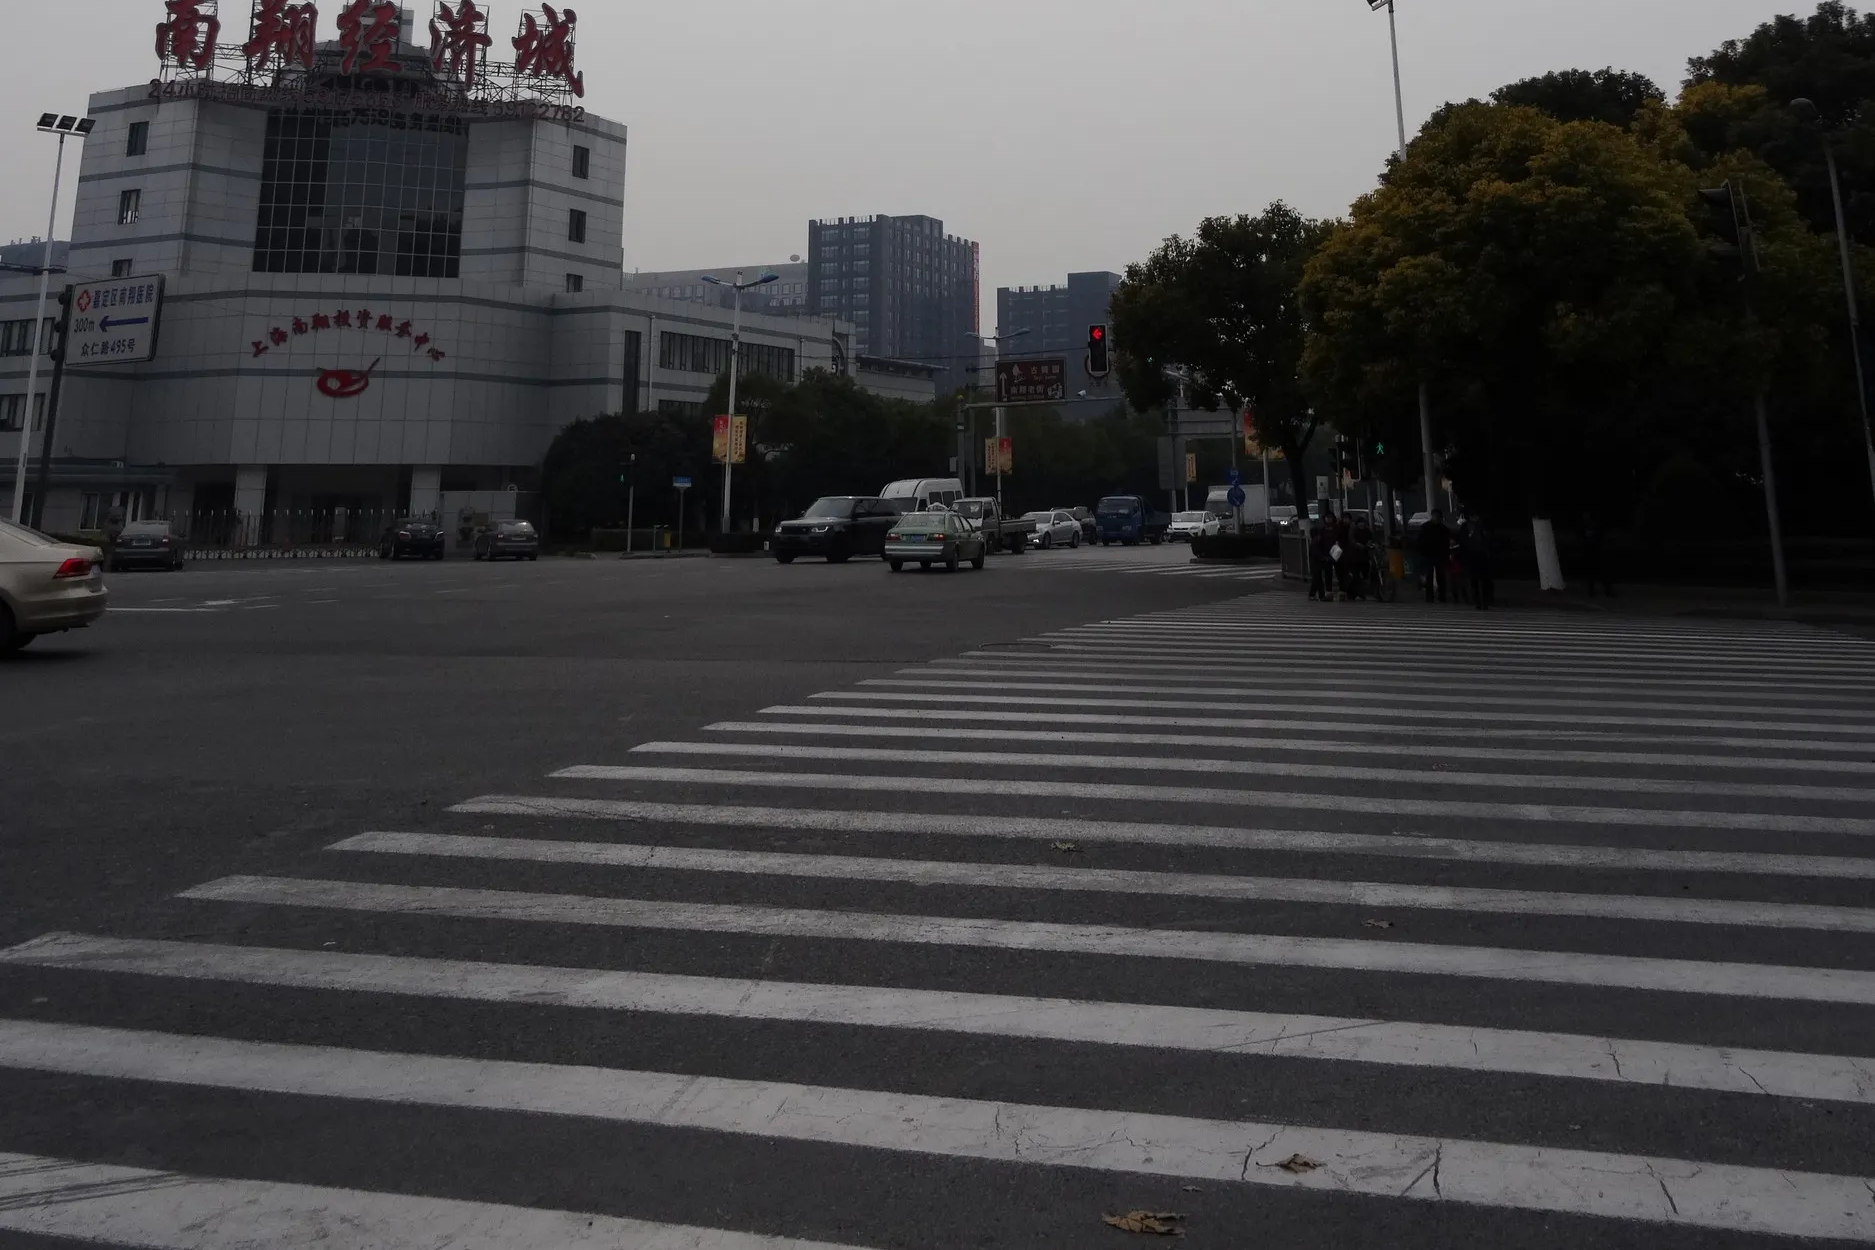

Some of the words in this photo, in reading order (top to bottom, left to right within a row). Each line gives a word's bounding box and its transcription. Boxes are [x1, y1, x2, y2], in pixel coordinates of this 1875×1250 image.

[93, 284, 154, 309] 嘉定区南翔医院
[74, 317, 95, 333] 300m
[252, 309, 446, 361] 上海南翔投资服务中心
[81, 338, 135, 356] 众仁路495号
